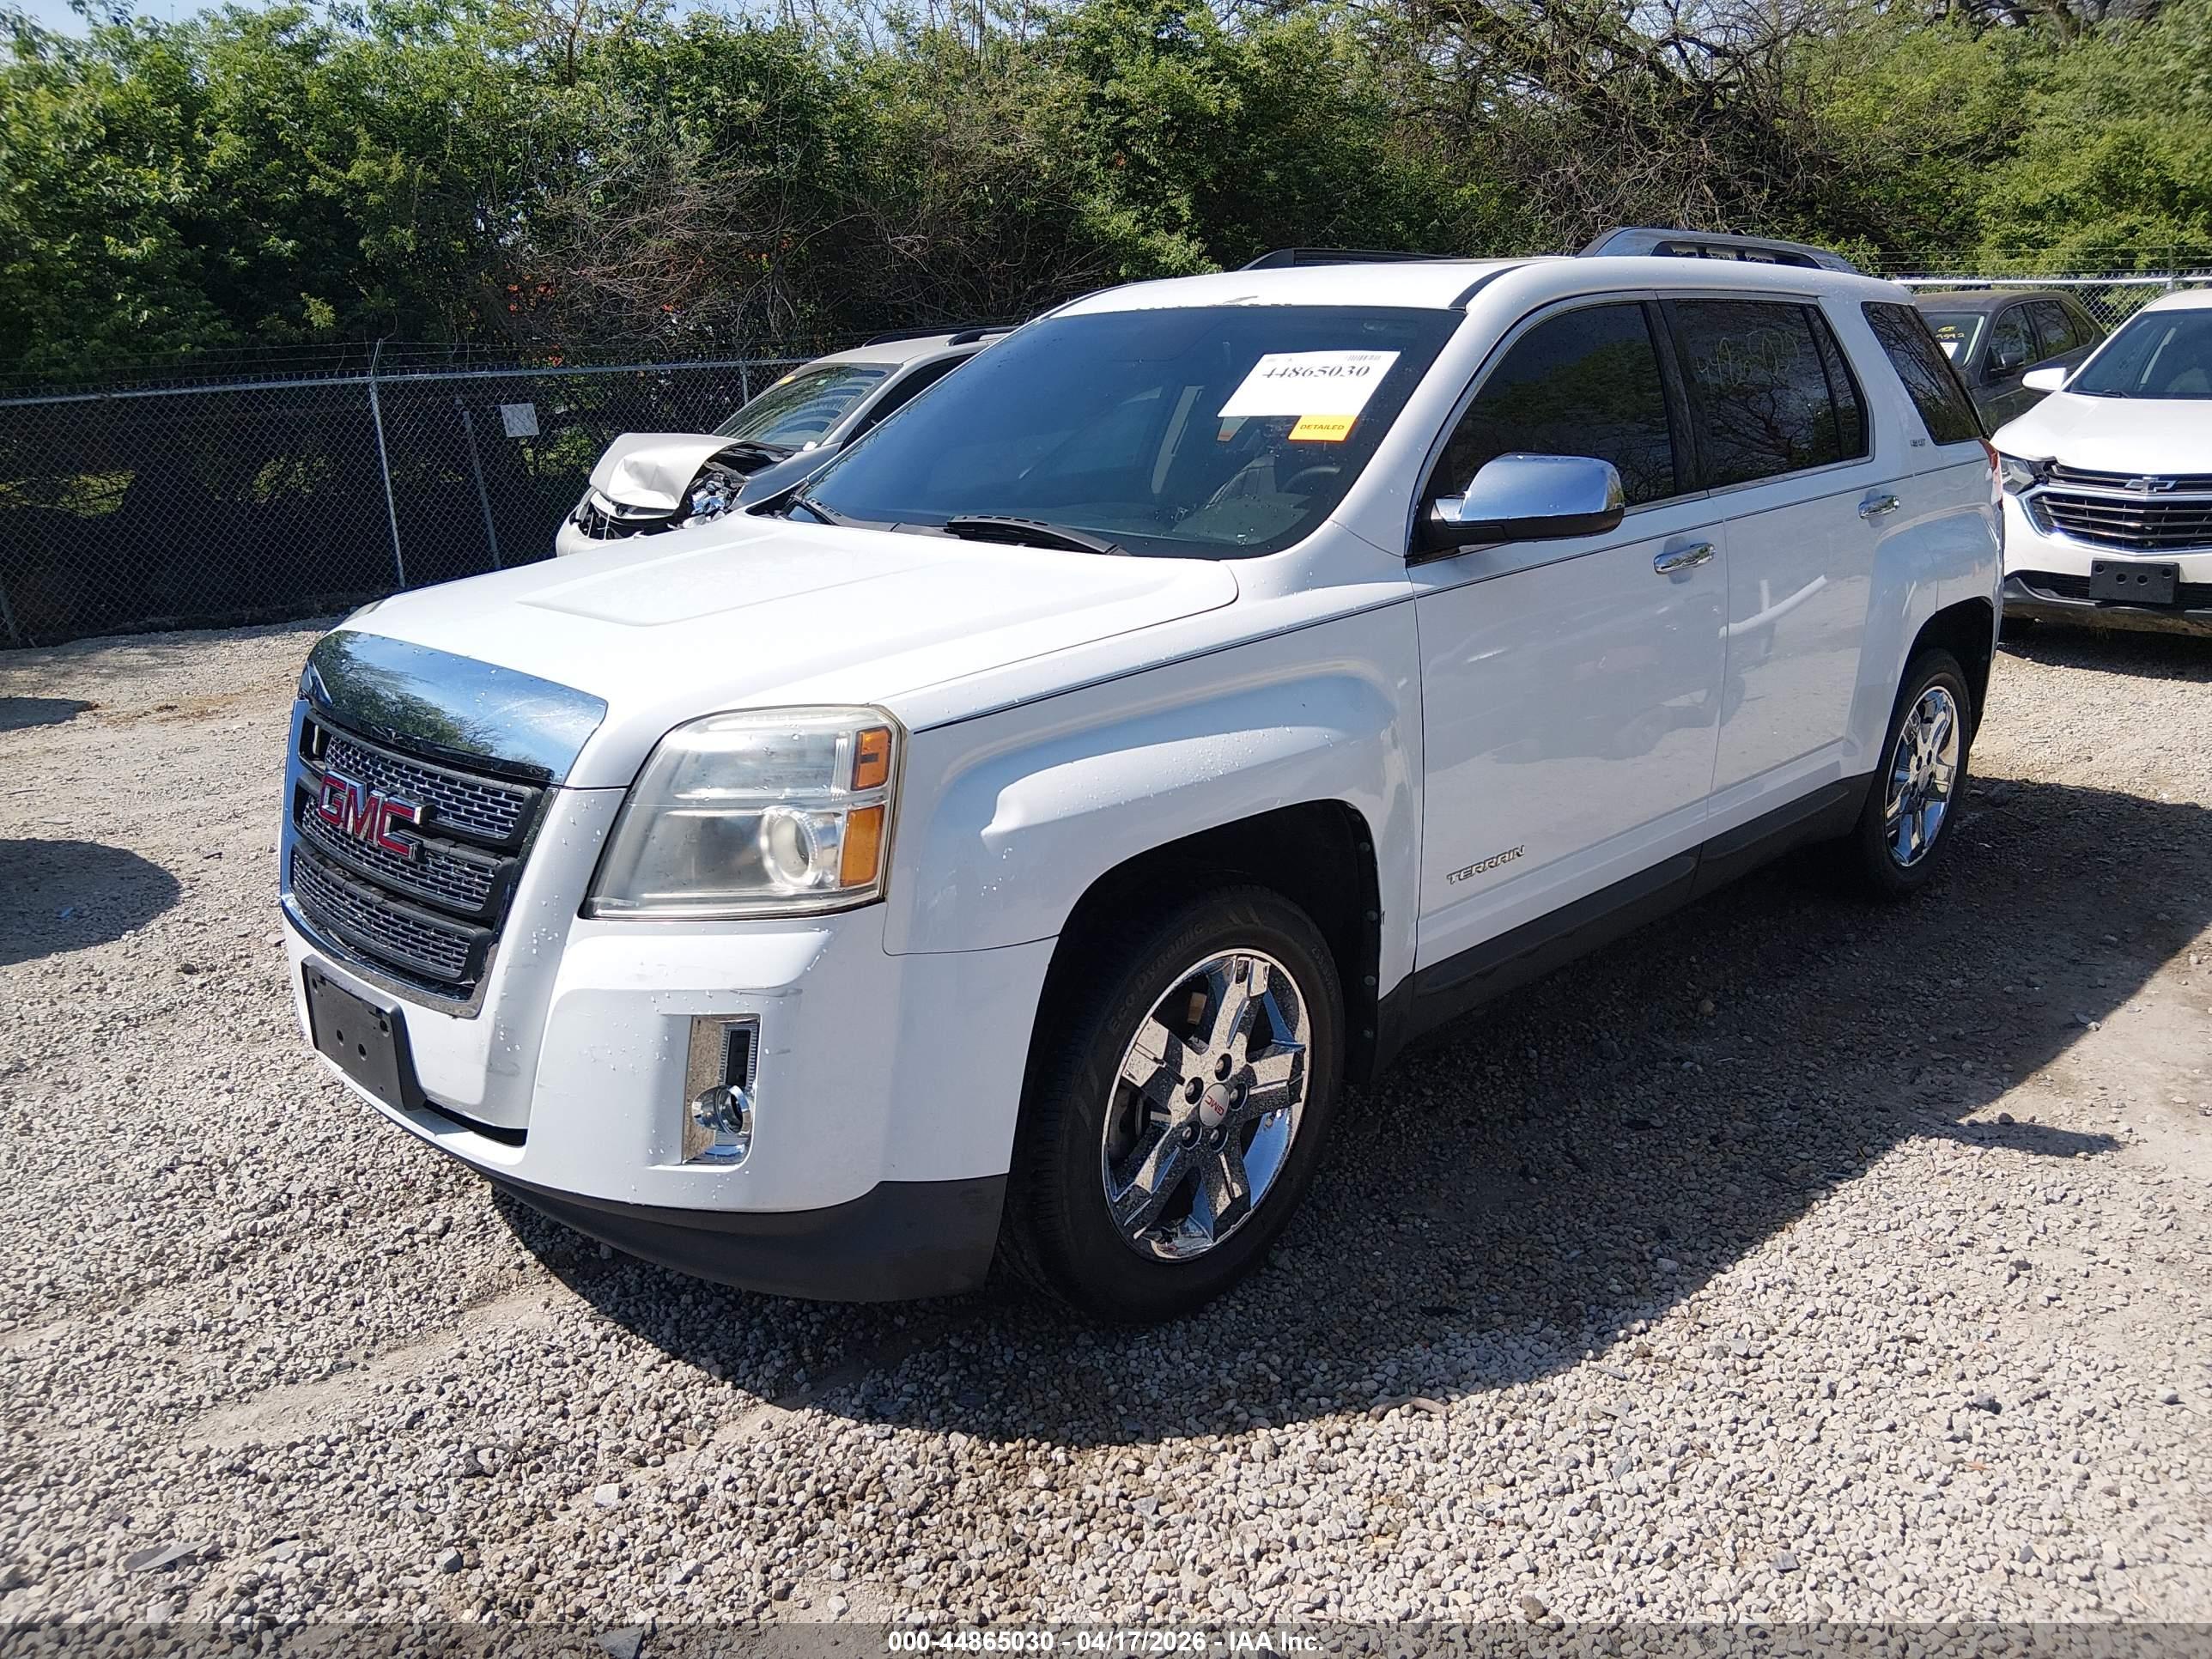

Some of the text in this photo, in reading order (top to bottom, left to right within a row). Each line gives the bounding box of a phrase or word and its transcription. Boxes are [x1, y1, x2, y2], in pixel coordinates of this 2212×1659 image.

[1262, 365, 1370, 379] 44865030
[319, 770, 423, 860] GMC
[1446, 845, 1525, 884] TERRAIN
[1204, 1095, 1224, 1116] GMC
